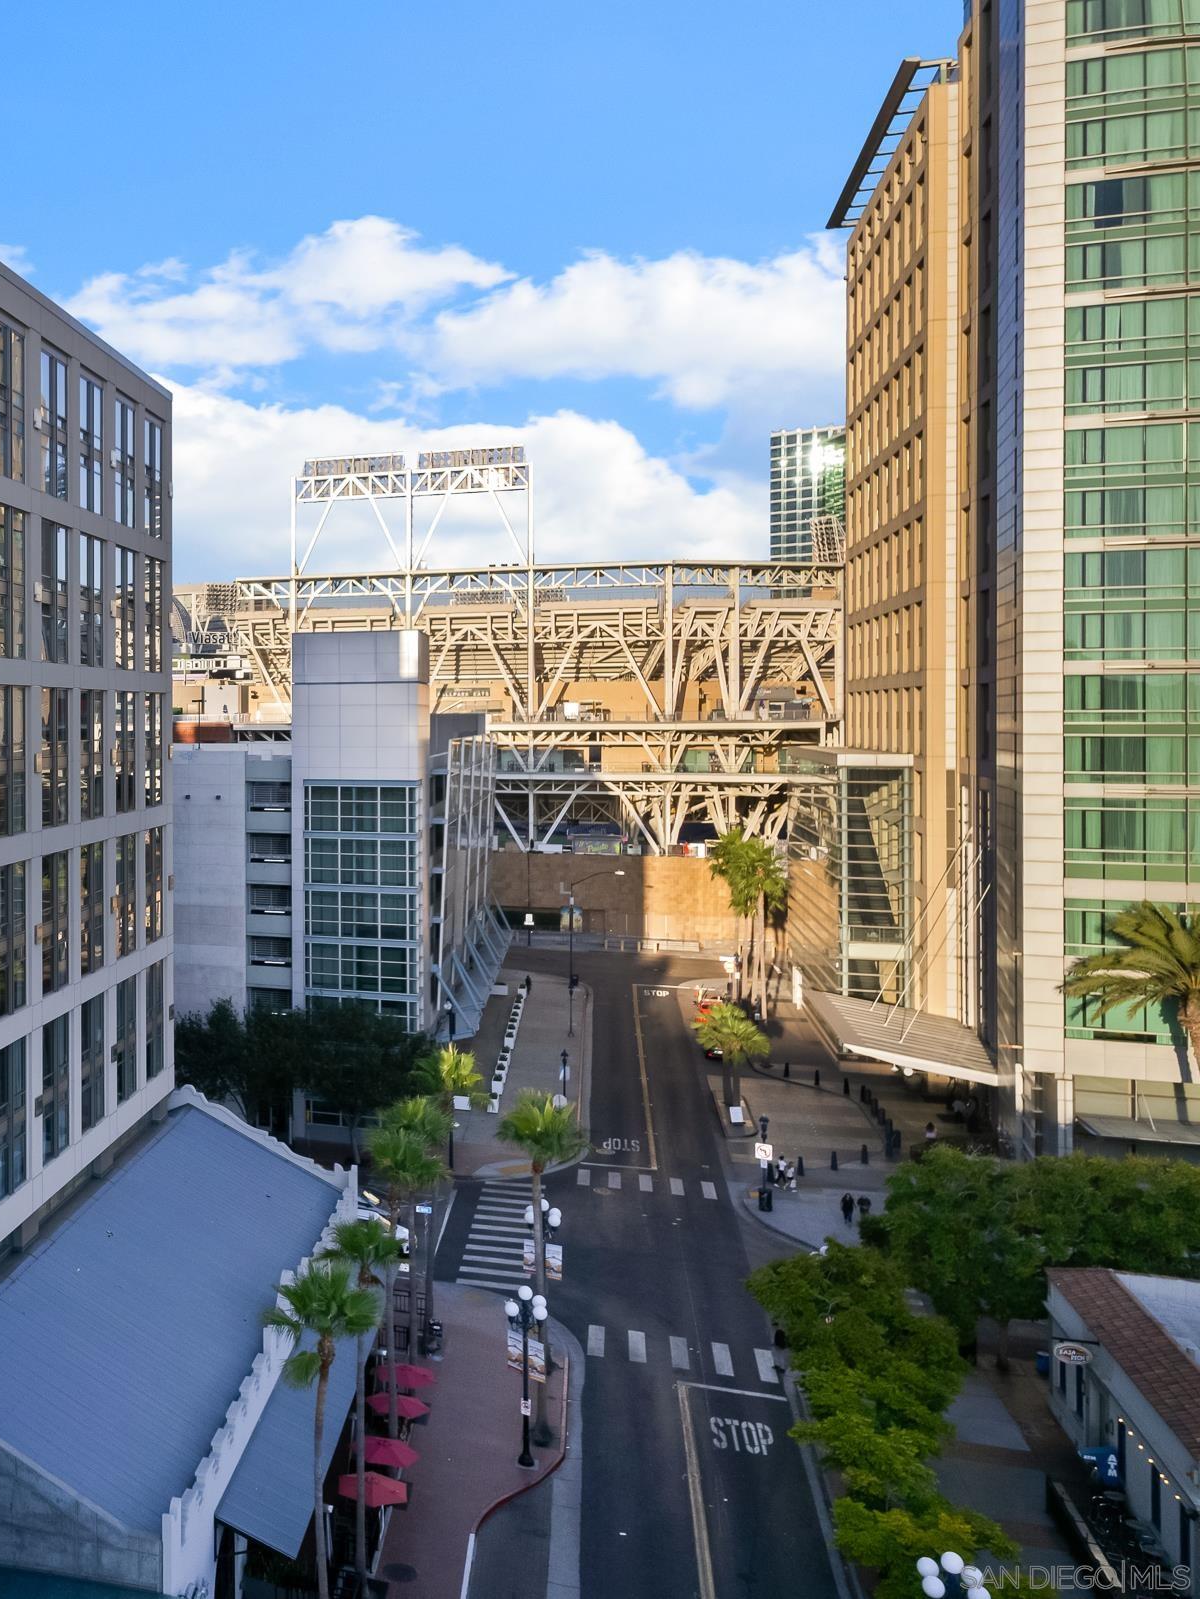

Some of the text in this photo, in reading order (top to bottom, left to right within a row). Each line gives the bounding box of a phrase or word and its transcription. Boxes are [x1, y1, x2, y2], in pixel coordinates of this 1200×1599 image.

[191, 631, 232, 644] Viasat
[643, 989, 670, 997] STOP
[603, 1138, 640, 1152] STOP
[710, 1416, 774, 1455] STOP
[1107, 1454, 1117, 1477] ATM
